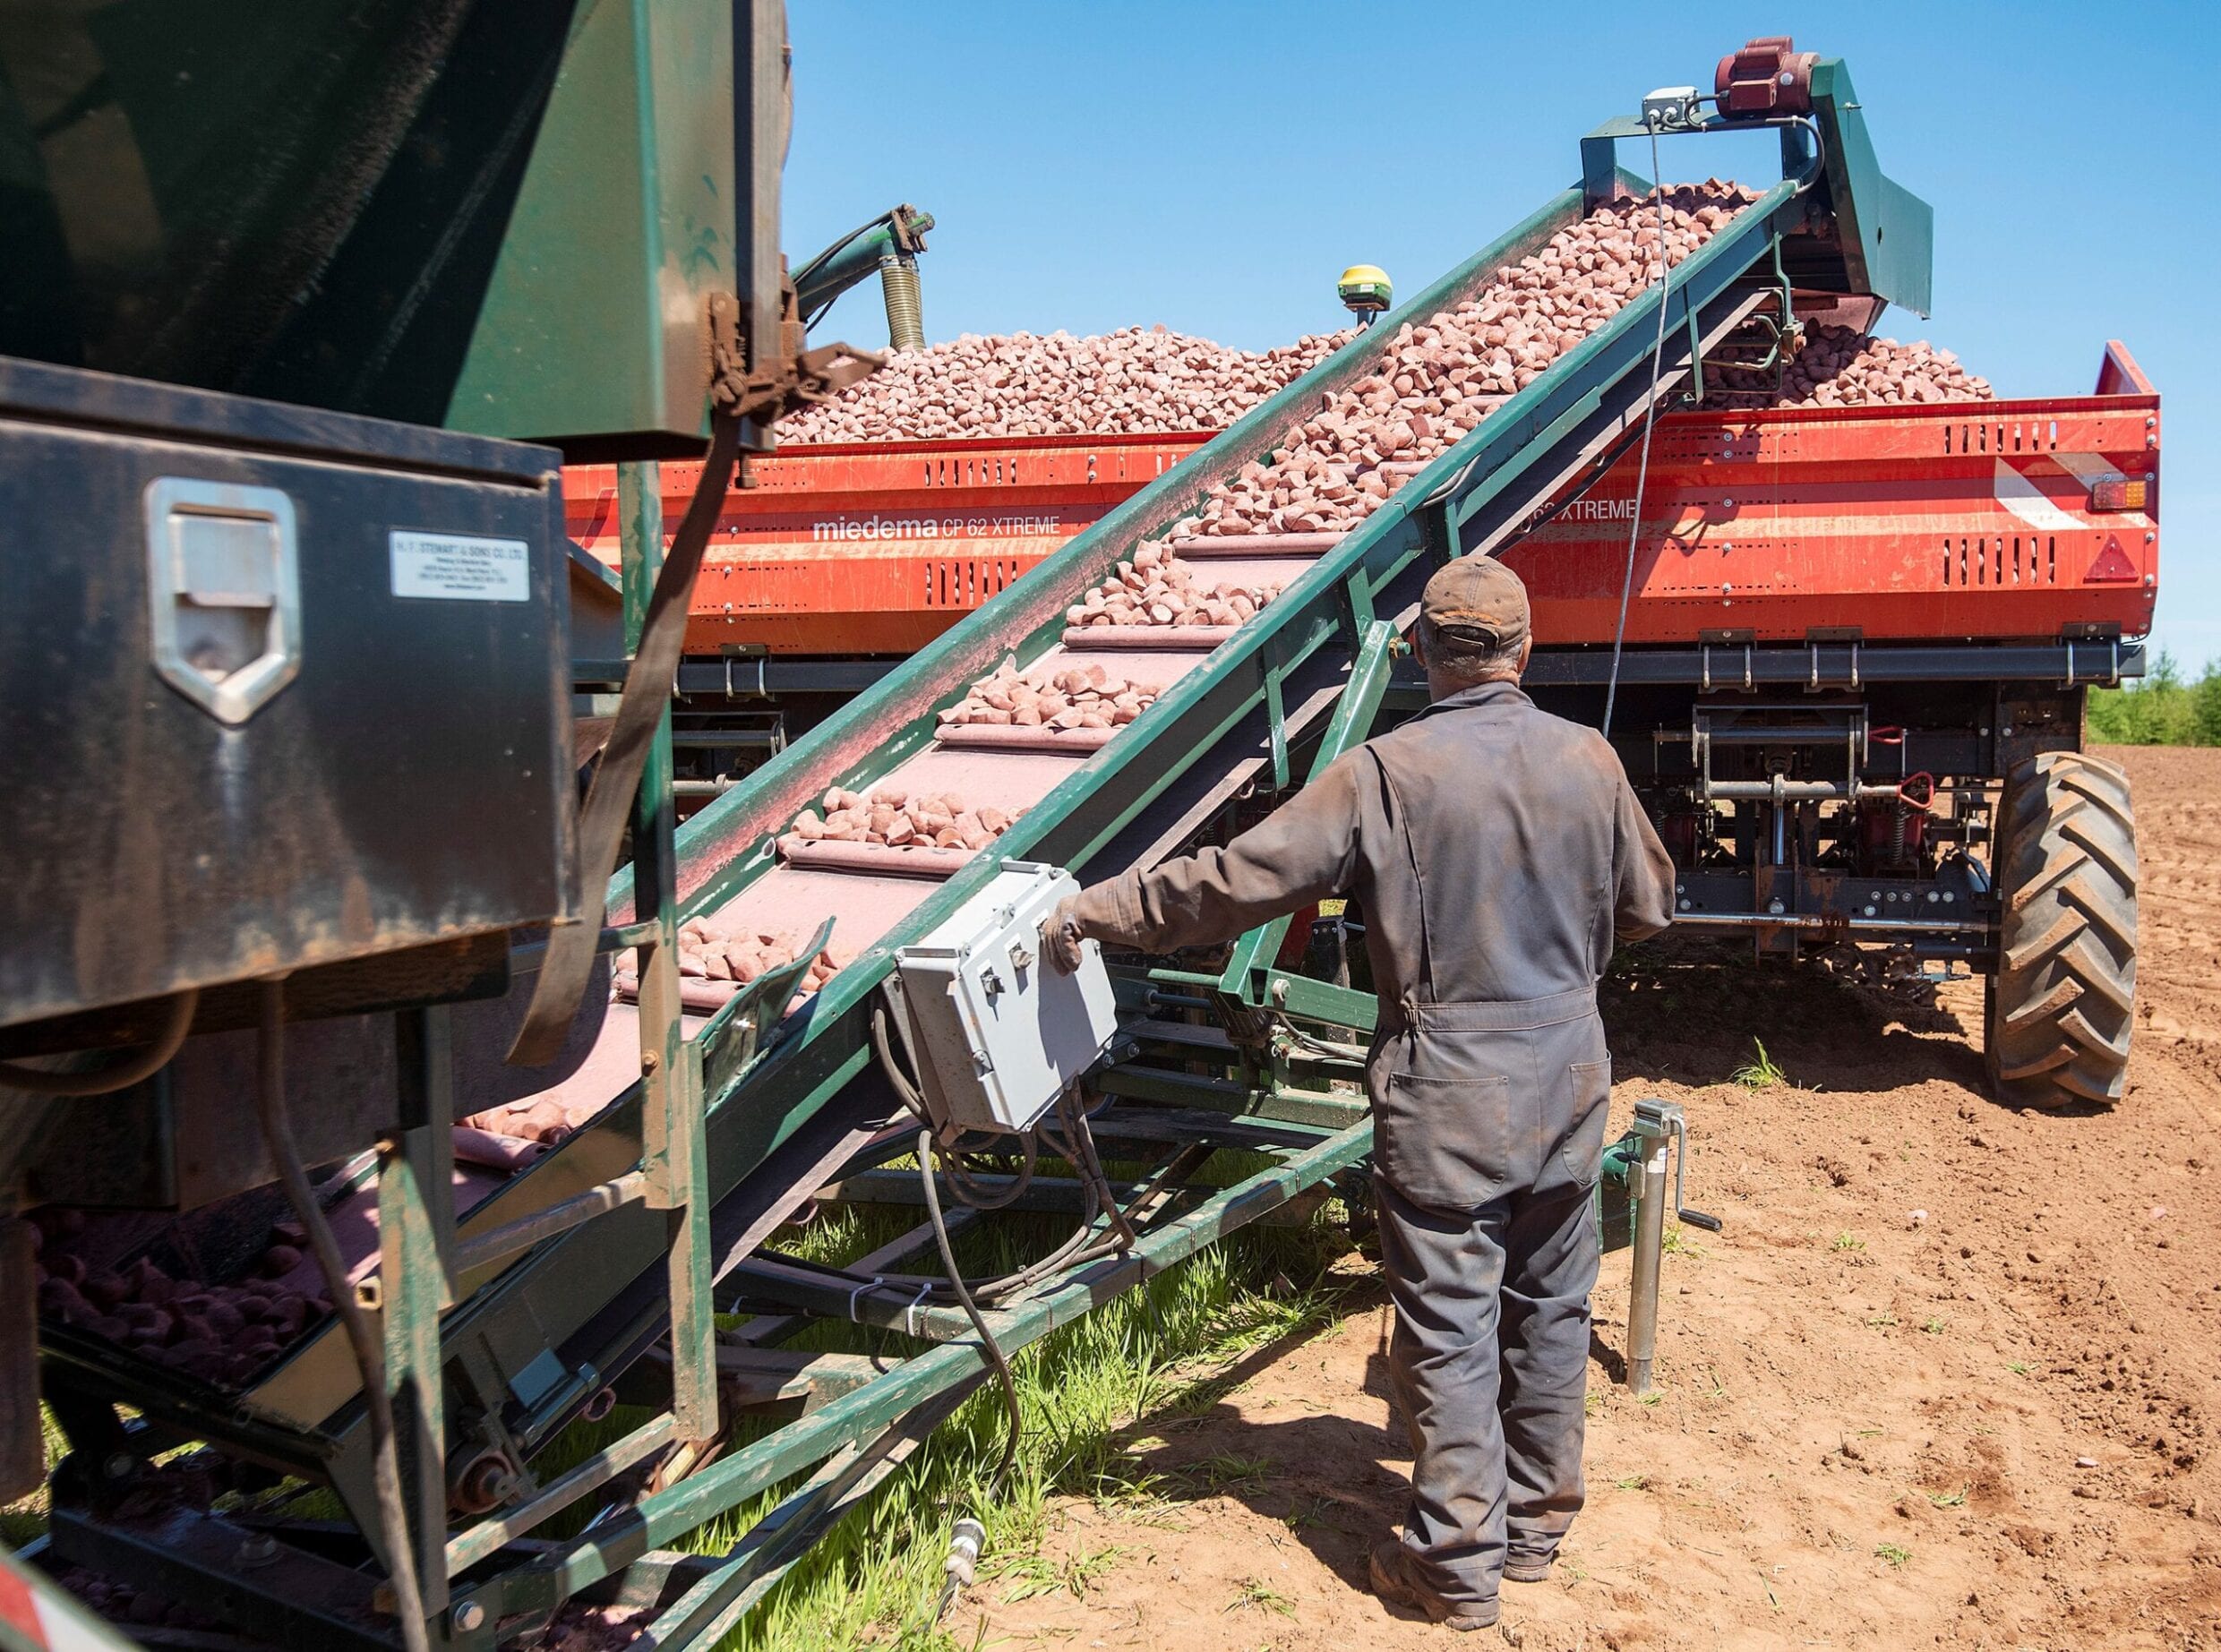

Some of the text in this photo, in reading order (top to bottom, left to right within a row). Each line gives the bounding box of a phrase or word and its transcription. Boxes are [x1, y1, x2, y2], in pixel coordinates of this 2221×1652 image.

[1561, 499, 1637, 520] XTREME
[813, 515, 1060, 541] miedema CP 62 XTREME
[420, 542, 459, 554] STEWART
[469, 545, 491, 557] SONS
